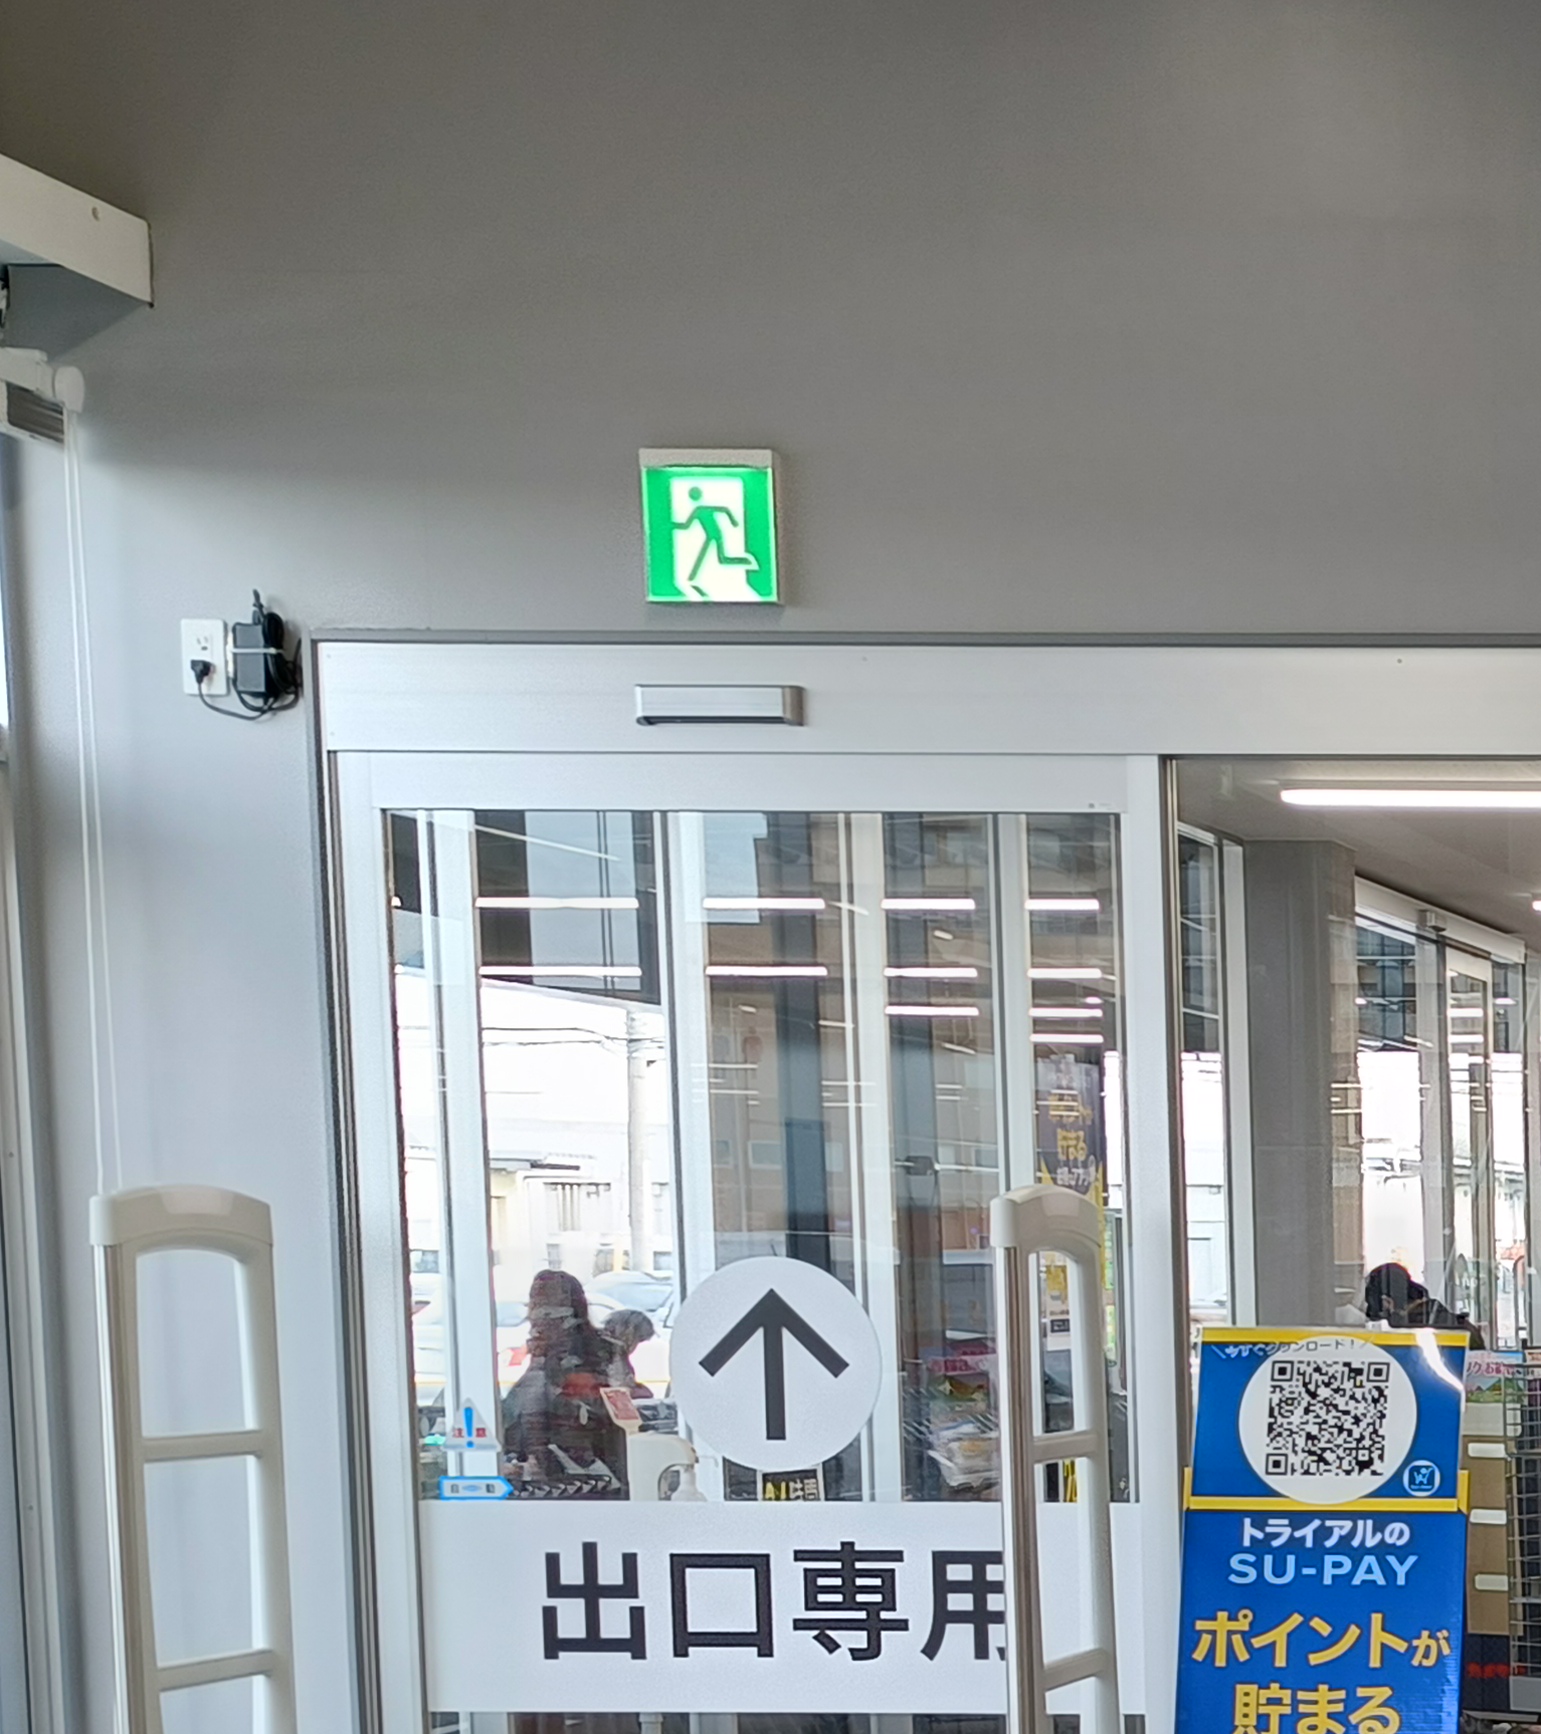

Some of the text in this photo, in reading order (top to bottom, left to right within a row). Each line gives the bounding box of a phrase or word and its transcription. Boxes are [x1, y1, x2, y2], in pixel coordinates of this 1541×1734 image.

[1242, 1518, 1410, 1549] トライアルの
[1228, 1553, 1418, 1586] SU-PAY
[542, 1541, 1006, 1661] 出口専用
[1192, 1609, 1450, 1669] ポイントが
